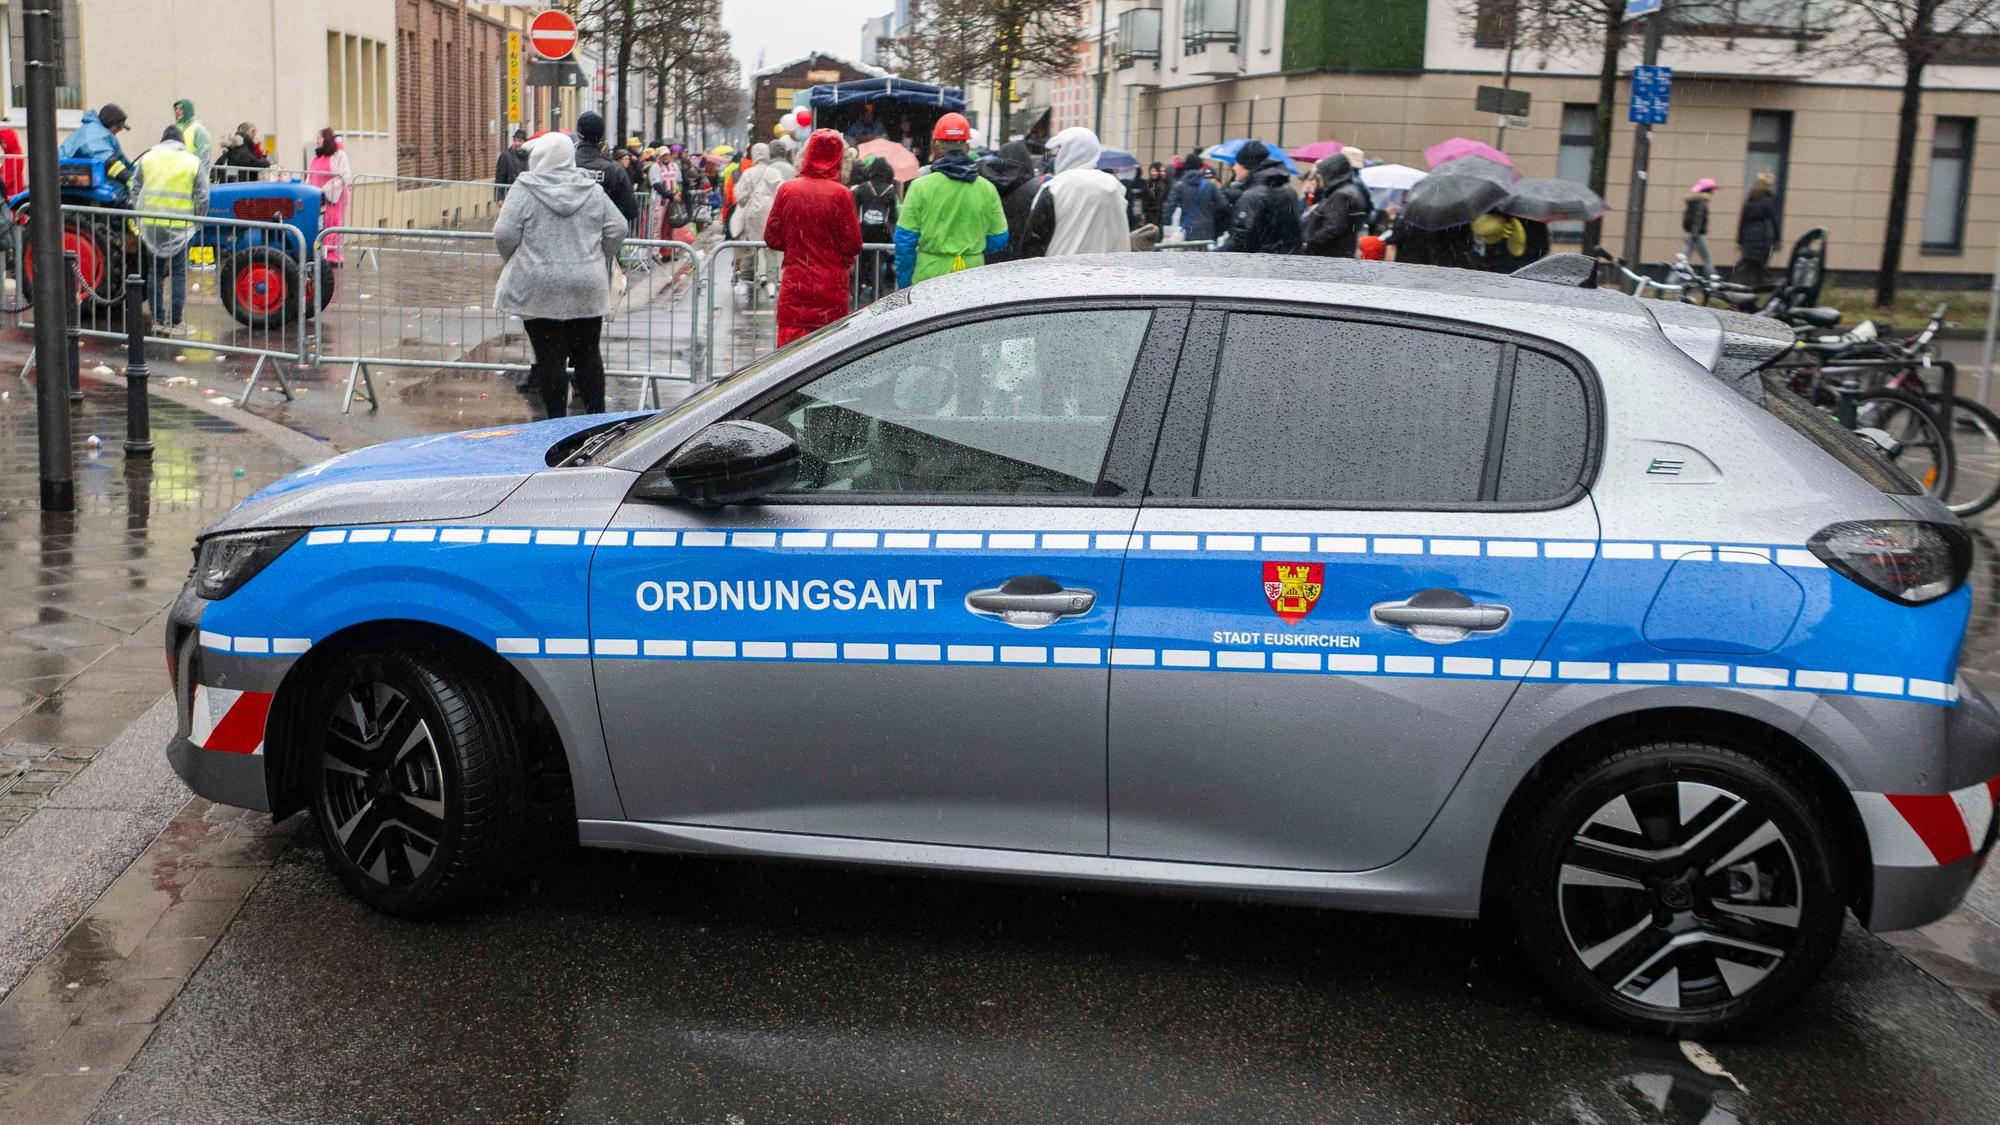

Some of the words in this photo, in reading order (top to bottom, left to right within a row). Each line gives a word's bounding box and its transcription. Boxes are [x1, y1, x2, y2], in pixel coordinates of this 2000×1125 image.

[636, 579, 943, 611] ORDNUNGSAMT
[1213, 631, 1260, 645] STADT
[1264, 632, 1360, 648] EUSKIRCHEN
